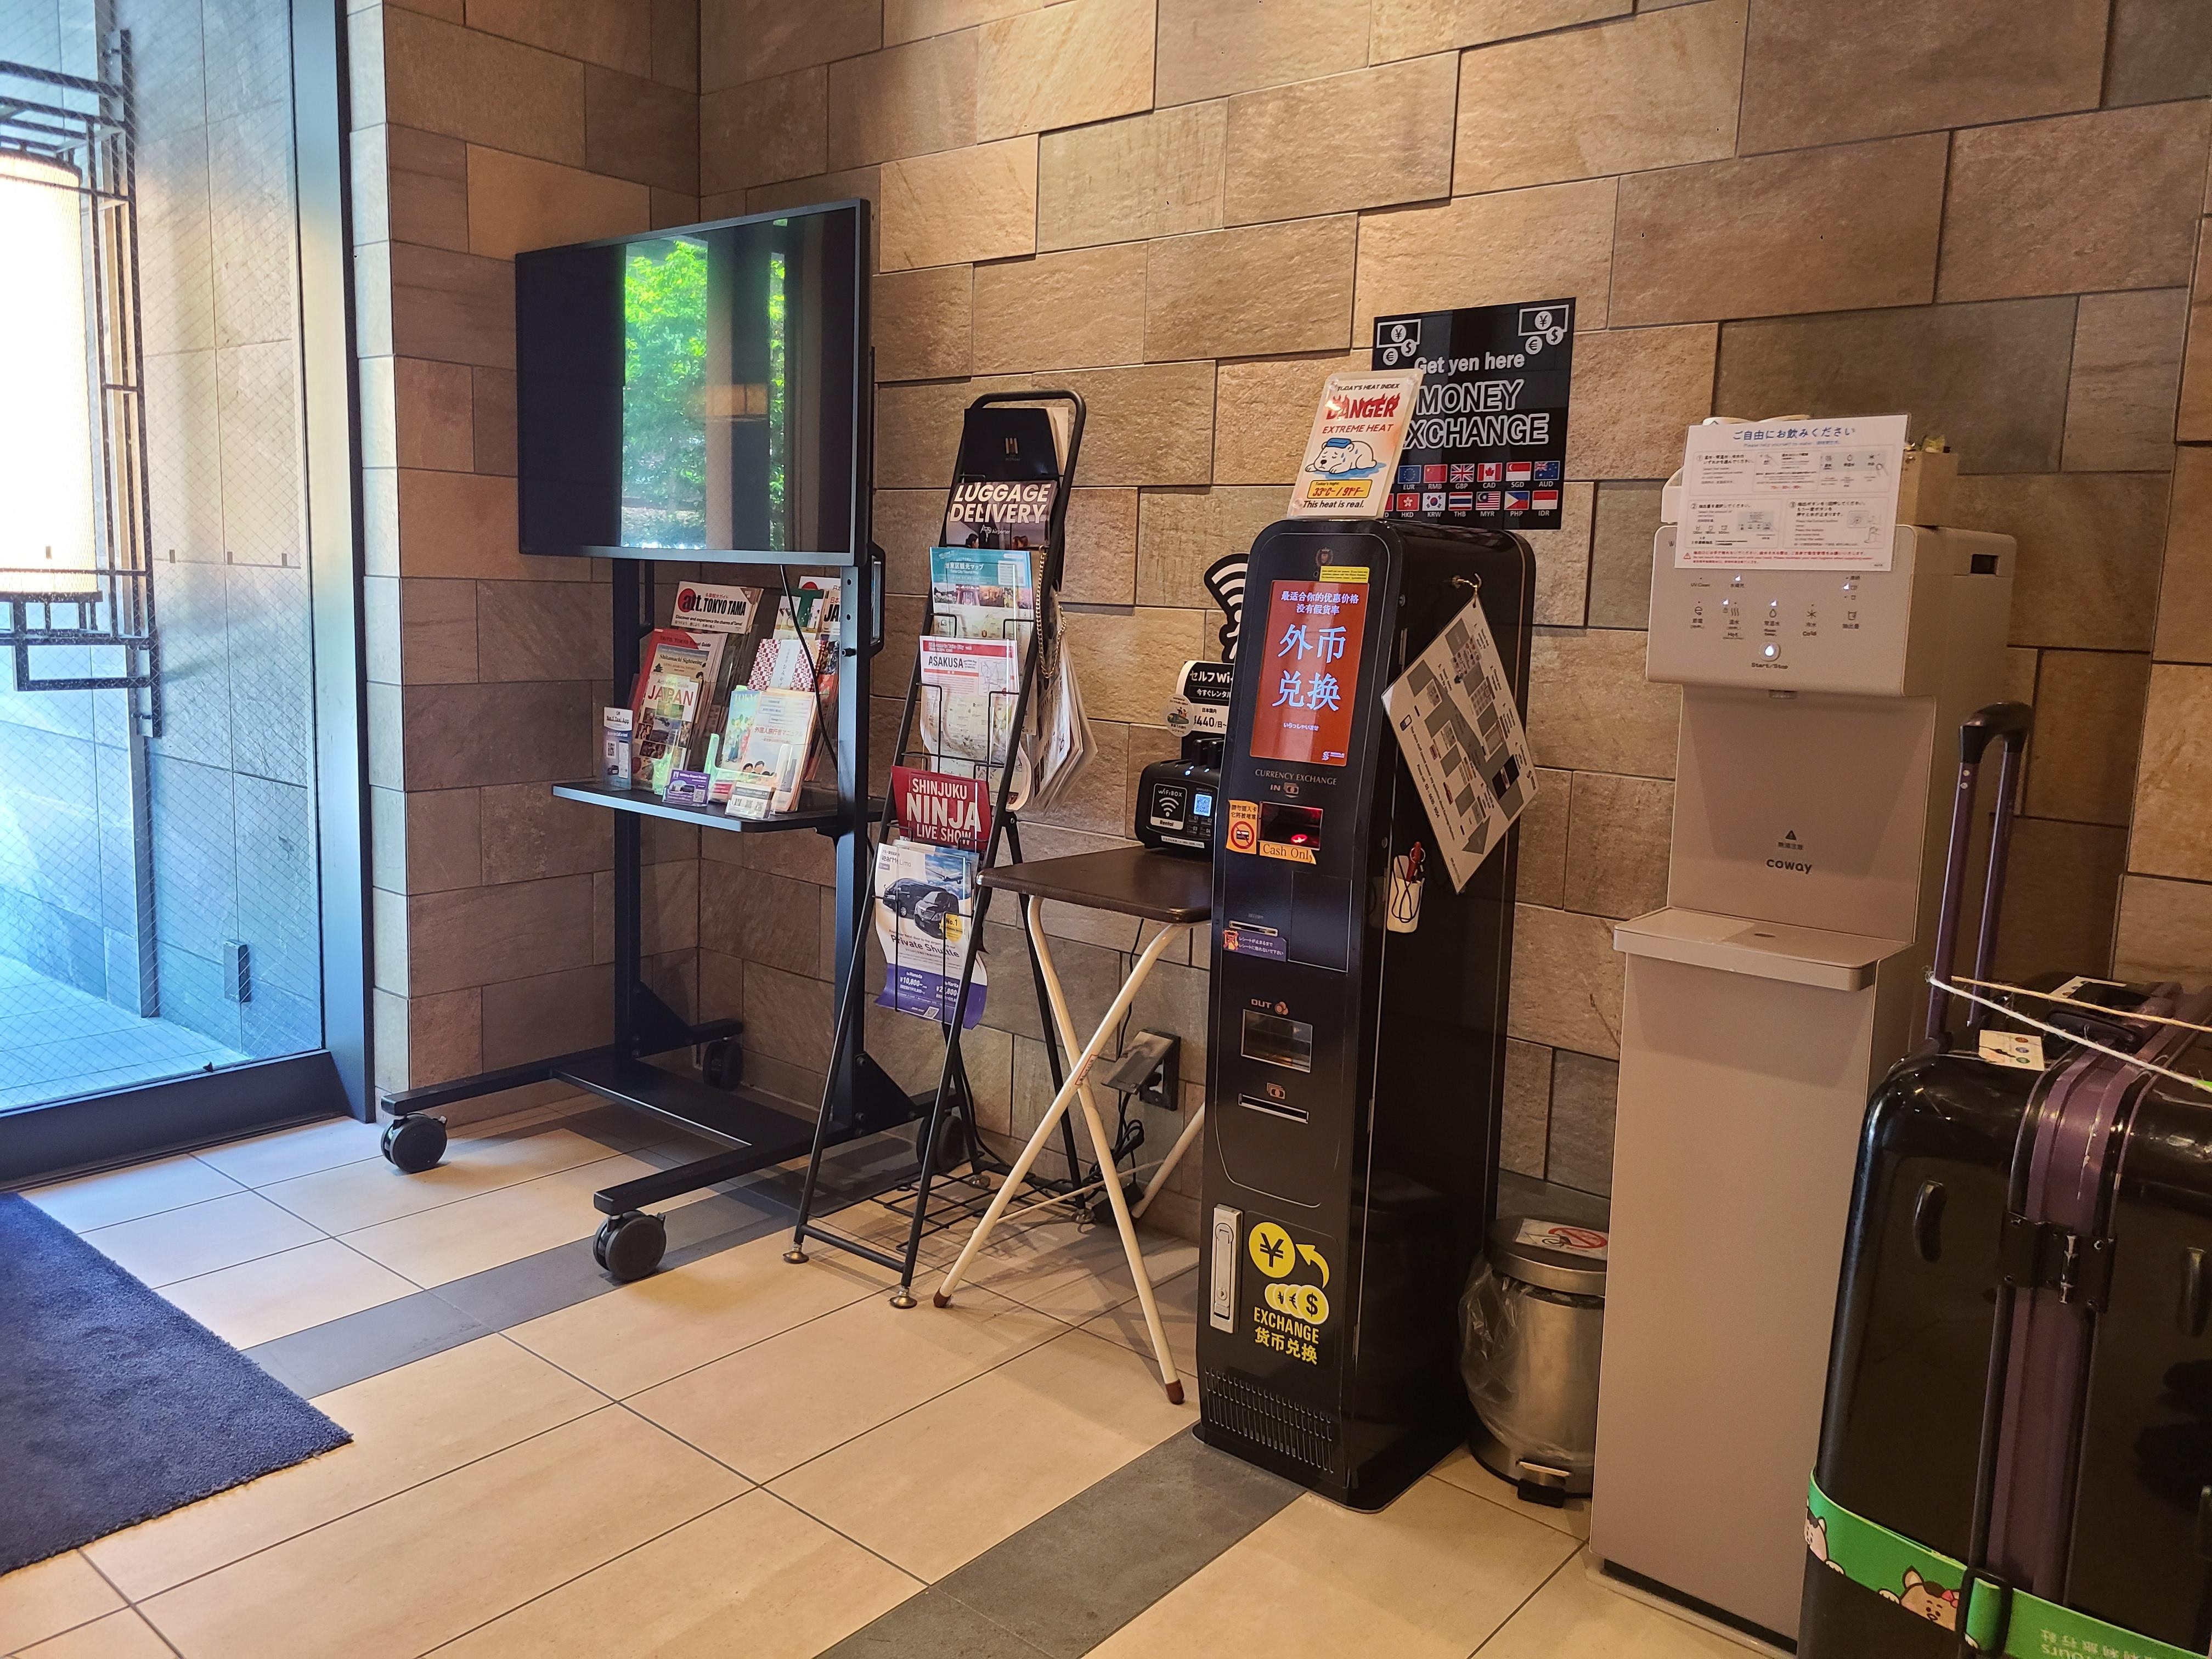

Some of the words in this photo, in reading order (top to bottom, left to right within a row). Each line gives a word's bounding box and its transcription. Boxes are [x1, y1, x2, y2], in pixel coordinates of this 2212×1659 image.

[1414, 357, 1445, 375] Get
[1448, 356, 1480, 376] yen
[1485, 352, 1525, 370] here
[1326, 393, 1401, 420] DANGER
[1416, 379, 1524, 415] MONEY
[1322, 425, 1365, 434] EXTREME
[1365, 424, 1393, 432] HEAT
[1402, 413, 1549, 449] XCHANGE
[1733, 427, 1856, 440] ご自由にお飲みください
[954, 484, 1051, 503] LUGGAGE
[950, 503, 1047, 523] DELIVERY
[703, 598, 727, 614] TOKYO
[727, 601, 747, 616] TAMA
[1281, 591, 1359, 604] 最适合你的优惠价格
[1277, 624, 1347, 664] 外币
[928, 656, 964, 668] ASAKUSA
[648, 685, 694, 706] JAPAN
[1272, 670, 1342, 712] 兑换
[1255, 769, 1295, 780] CURRENCY
[1296, 774, 1337, 786] EXCHANGE
[912, 778, 967, 800] SHINJUKU
[906, 792, 981, 832] NINJA
[916, 824, 938, 840] LIVE
[940, 828, 972, 845] SHOW
[1263, 844, 1286, 857] Cash
[946, 918, 957, 926] No.1
[890, 934, 923, 950] Private
[1251, 998, 1272, 1009] OUT
[1254, 1306, 1319, 1345] EXCHANGE
[1255, 1326, 1318, 1365] 货币兑换
